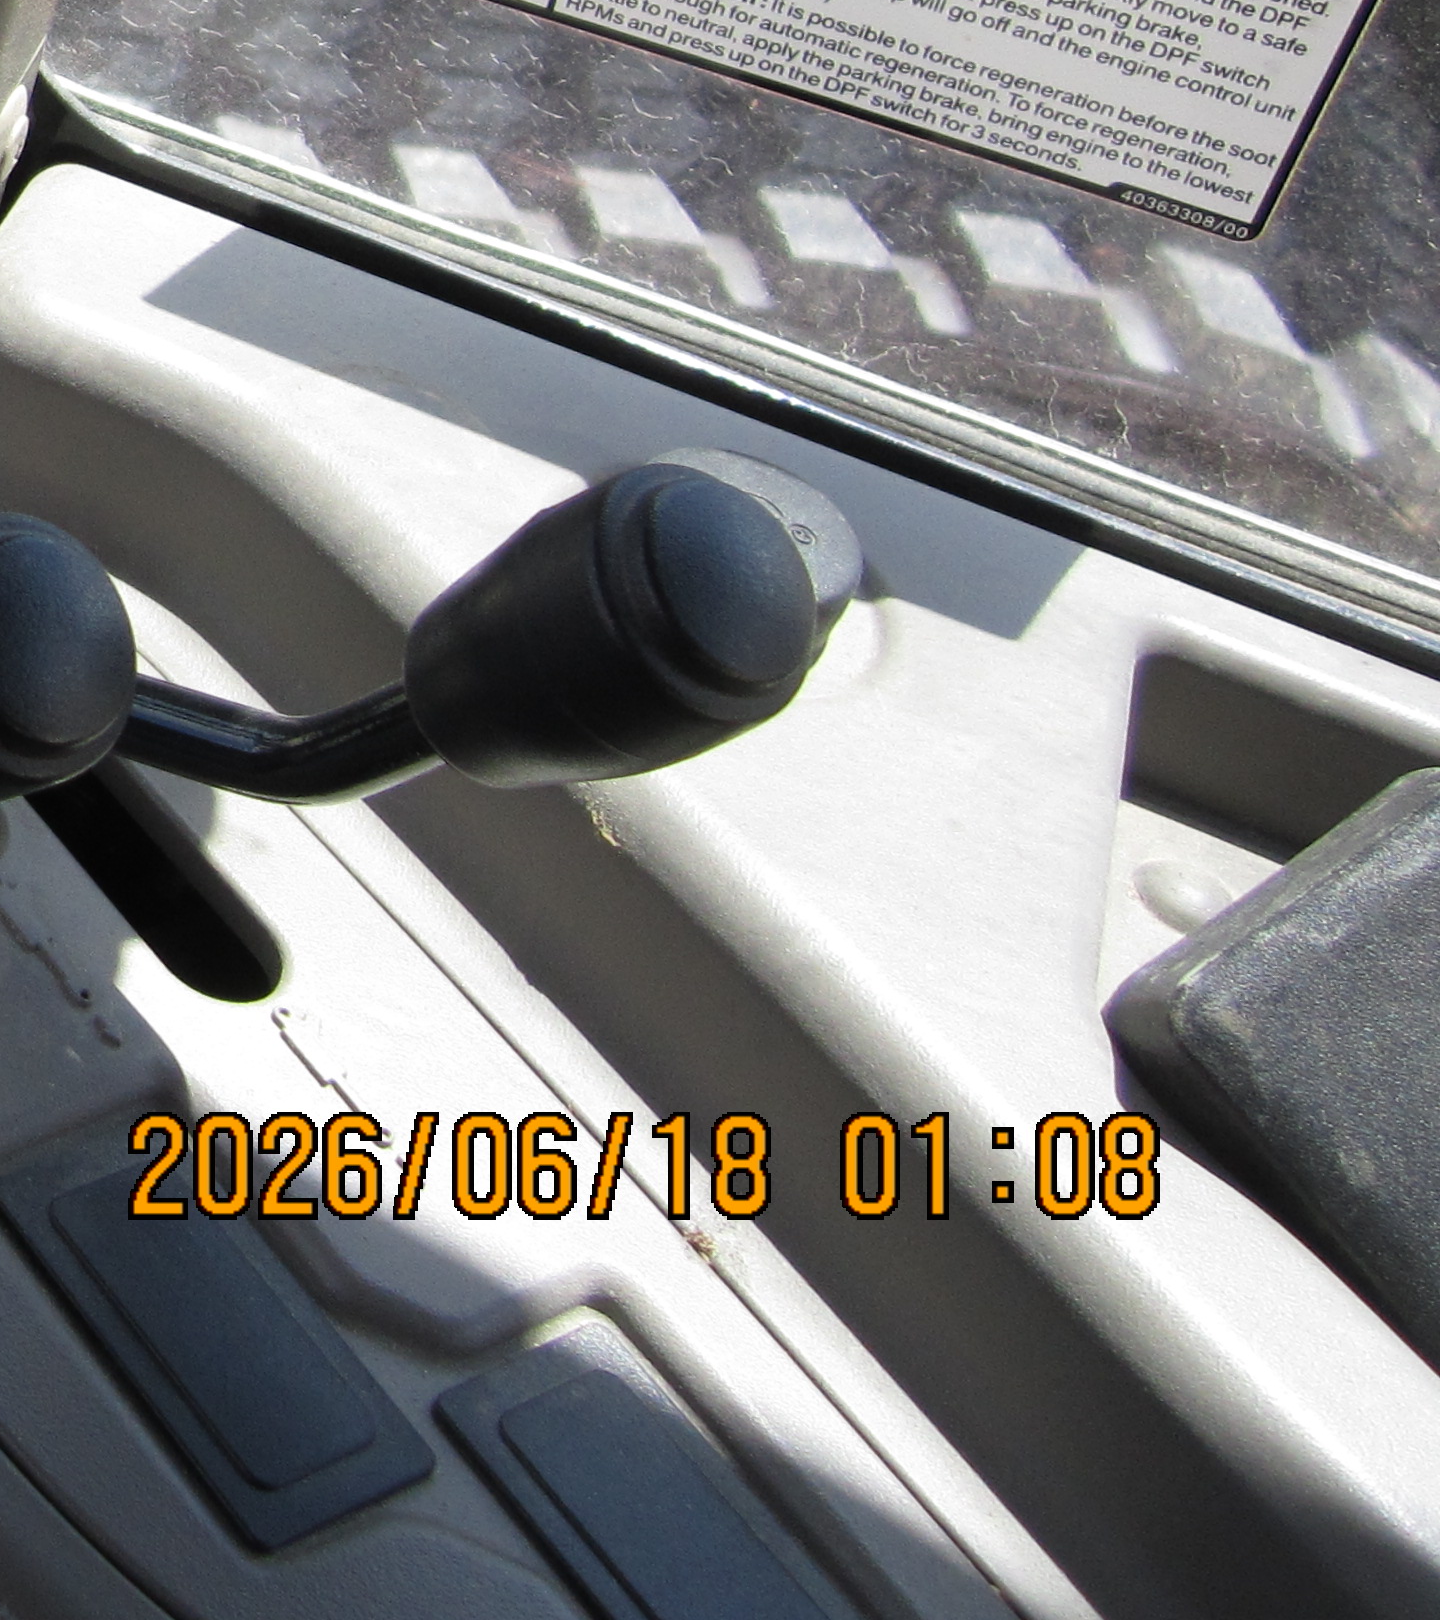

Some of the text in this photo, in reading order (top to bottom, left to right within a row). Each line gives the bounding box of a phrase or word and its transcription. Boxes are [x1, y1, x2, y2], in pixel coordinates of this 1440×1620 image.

[627, 18, 668, 38] and
[667, 31, 725, 57] press
[728, 49, 755, 68] up
[758, 59, 785, 76] on
[788, 66, 821, 87] the
[823, 76, 871, 100] DPF
[870, 95, 937, 125] switch
[940, 114, 971, 134] for
[971, 124, 986, 139] 3
[987, 132, 1081, 171] seconds.
[787, 2, 805, 20] is
[806, 12, 896, 48] possible
[899, 38, 920, 56] to
[922, 45, 977, 74] force
[979, 66, 1115, 117] regeneration
[1117, 106, 1189, 140] before
[1191, 130, 1226, 152] the
[1227, 144, 1277, 168] soot
[1120, 190, 1249, 239] 40363308/00
